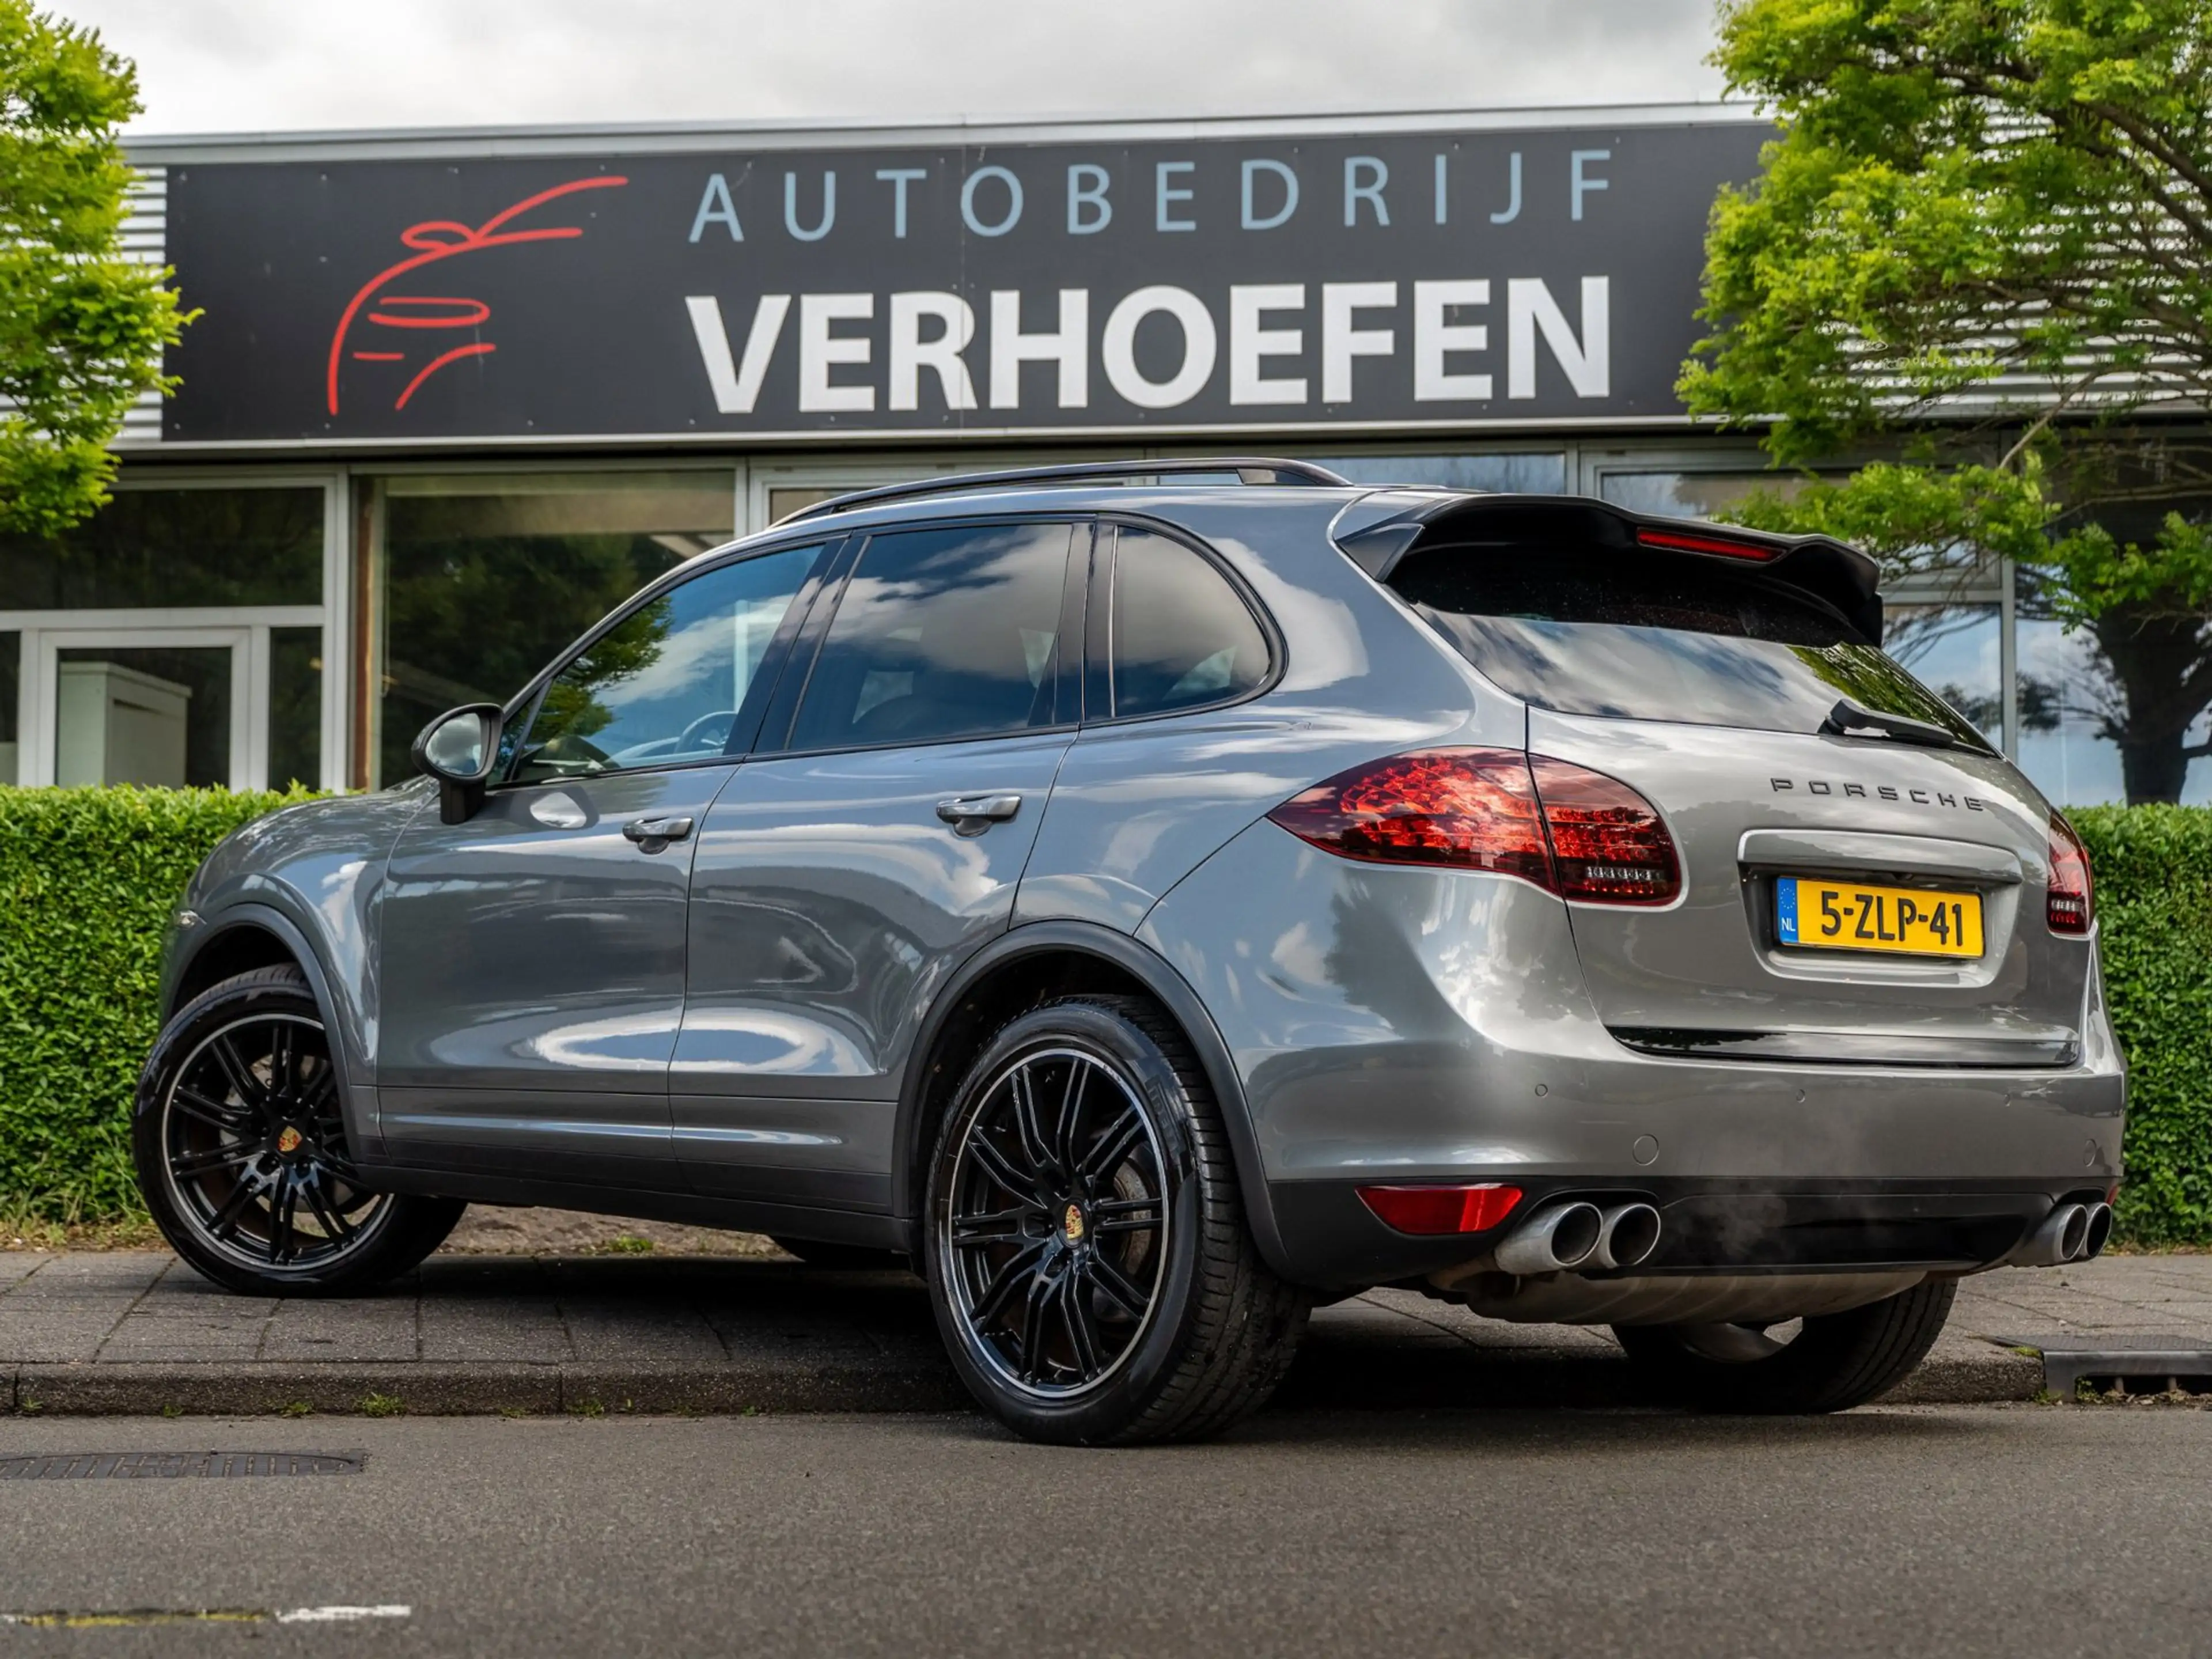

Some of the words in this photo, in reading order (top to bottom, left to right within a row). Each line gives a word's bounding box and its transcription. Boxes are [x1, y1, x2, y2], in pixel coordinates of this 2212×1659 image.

[688, 150, 1611, 244] AUTOBEDRIJF
[684, 275, 1610, 414] VERHOEFEN
[1770, 777, 1984, 812] PORSCHE
[1781, 917, 1796, 932] NL
[1821, 890, 1963, 947] 5-ZLP-41
